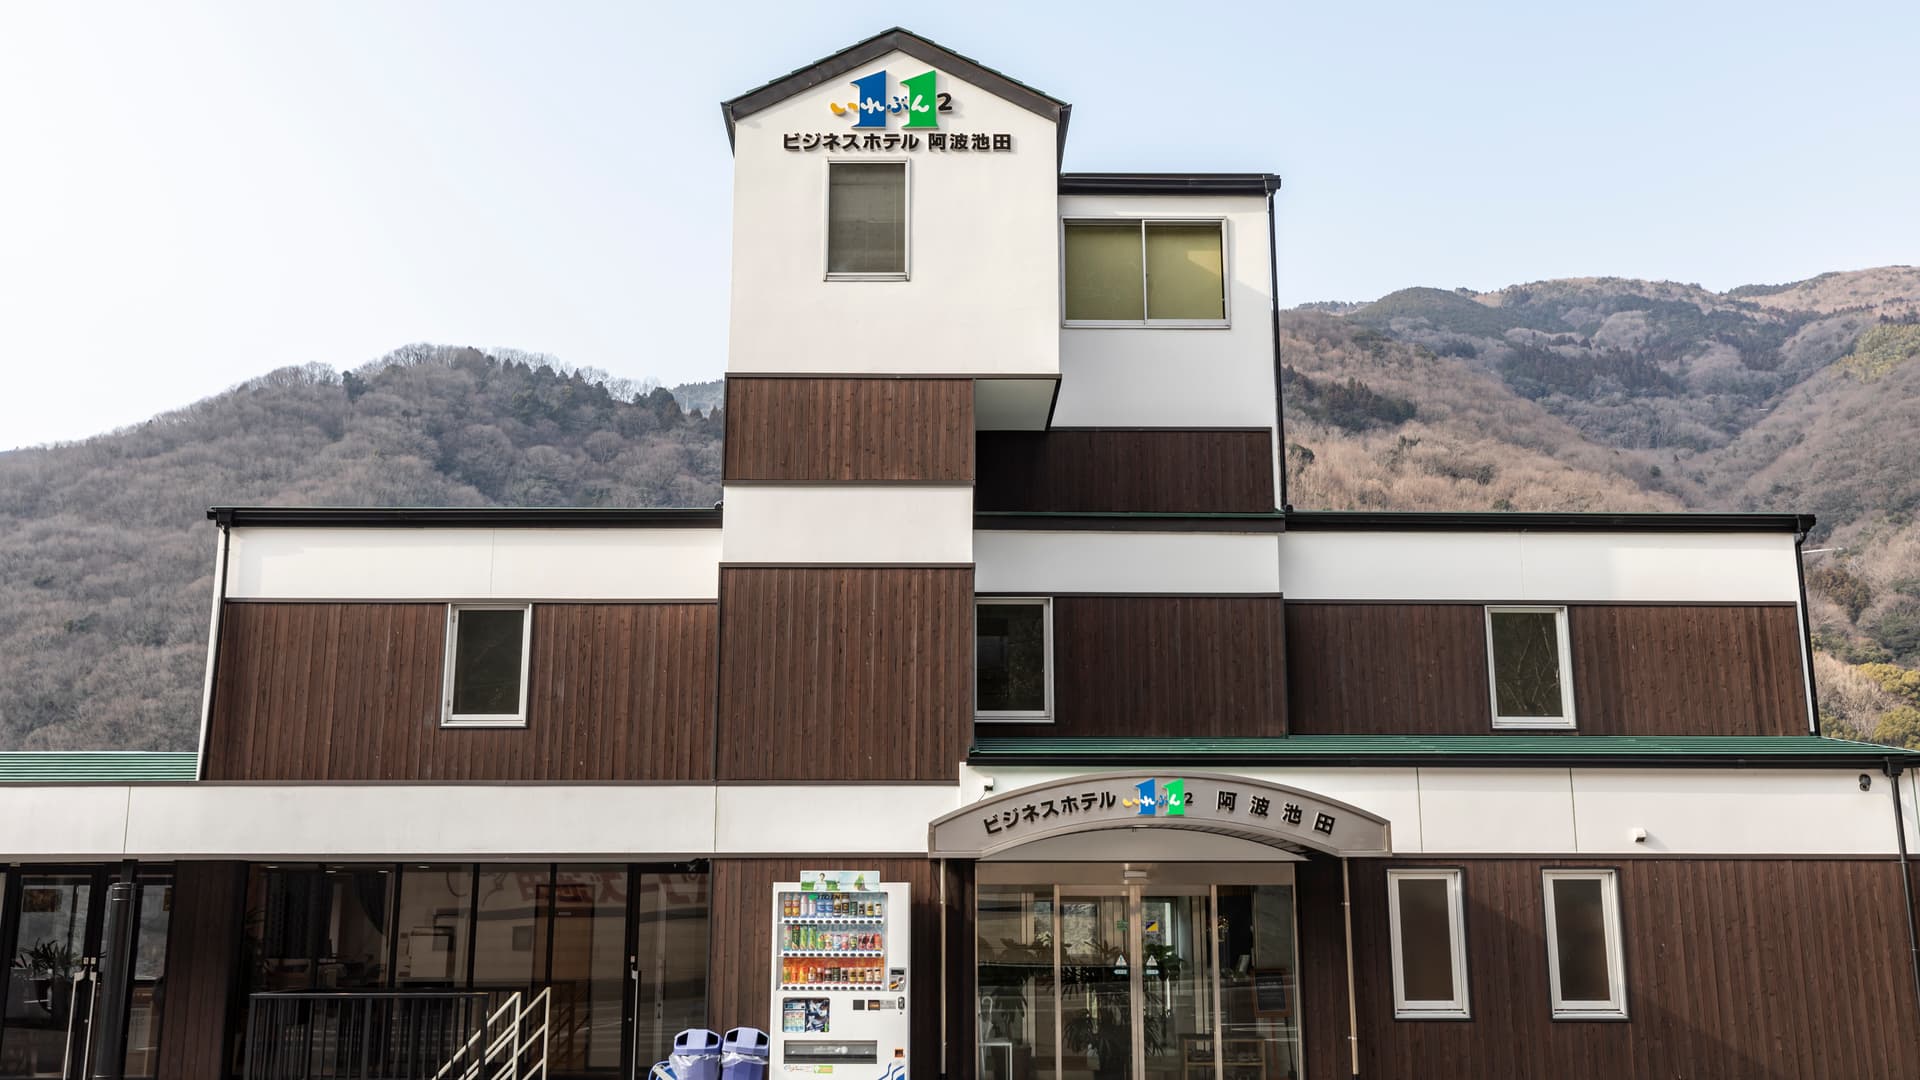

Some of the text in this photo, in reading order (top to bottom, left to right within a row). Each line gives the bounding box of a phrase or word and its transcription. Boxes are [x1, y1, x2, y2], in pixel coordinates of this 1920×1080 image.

[937, 93, 952, 111] 2
[783, 132, 1011, 151] ビジネスホテル 阿波池田
[983, 791, 1117, 835] ビジネスホテル
[1216, 790, 1336, 835] 阿波池田
